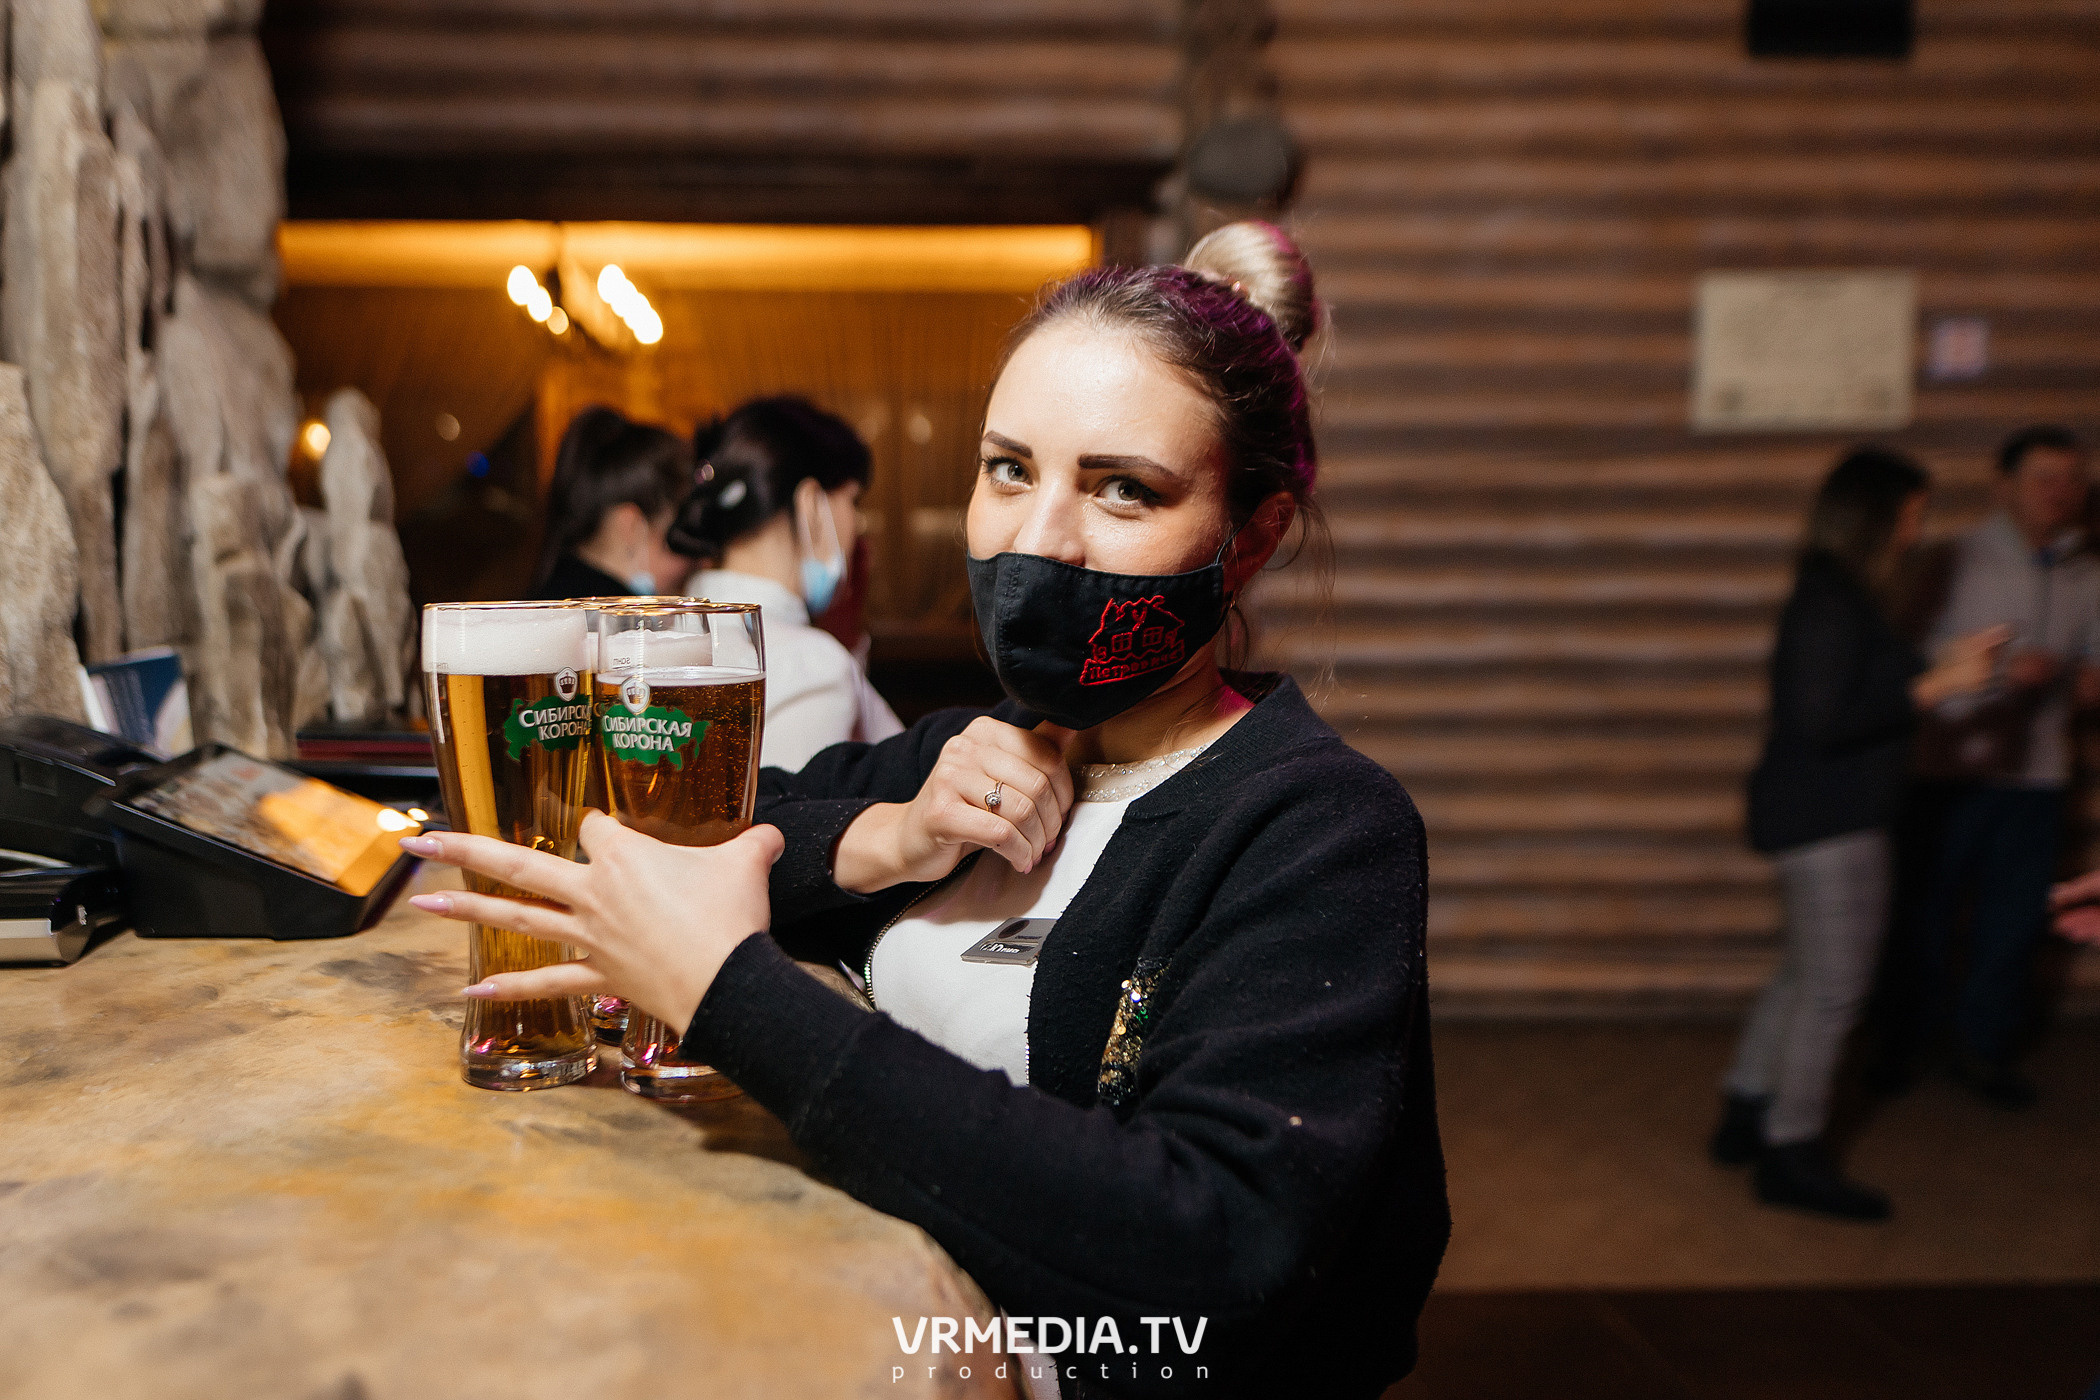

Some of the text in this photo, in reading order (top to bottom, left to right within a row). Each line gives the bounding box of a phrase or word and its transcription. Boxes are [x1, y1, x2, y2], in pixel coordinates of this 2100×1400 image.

[518, 704, 591, 728] СИБИРСК
[602, 715, 693, 738] СИБИРСКАЯ
[612, 733, 675, 752] КОРОНА
